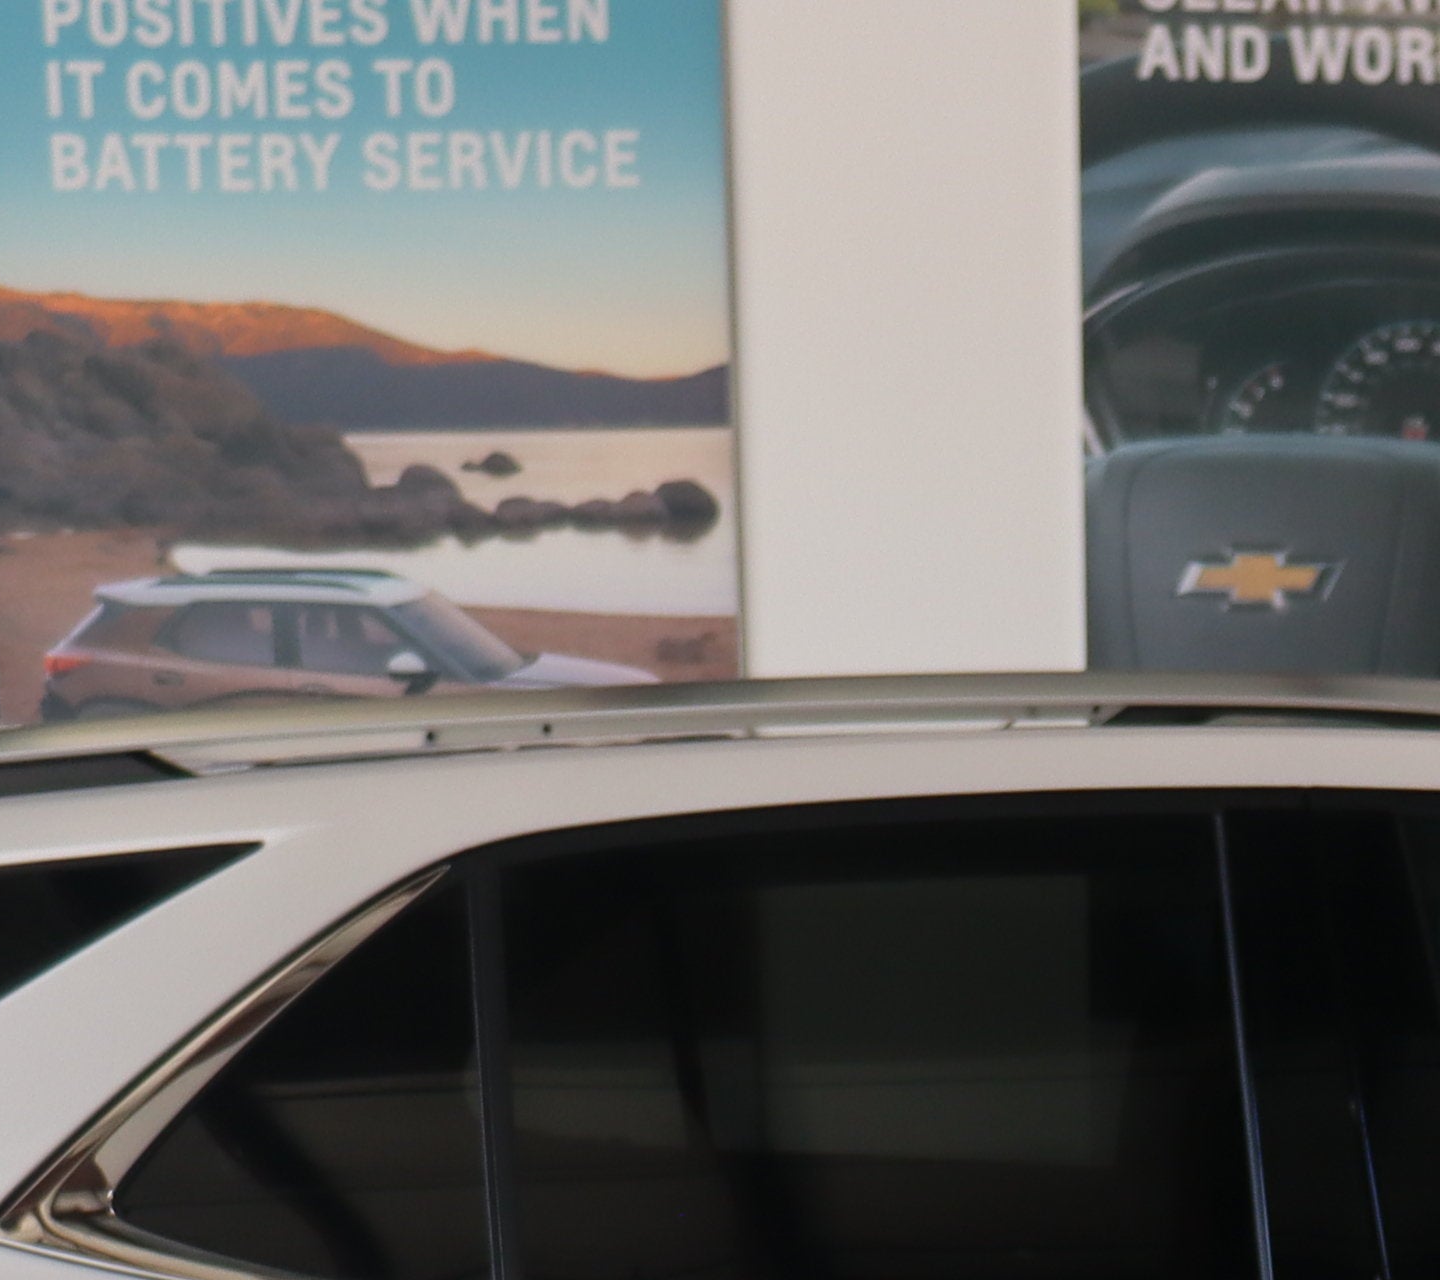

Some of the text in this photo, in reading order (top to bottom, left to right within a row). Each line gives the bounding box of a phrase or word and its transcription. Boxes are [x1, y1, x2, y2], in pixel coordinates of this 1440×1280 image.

[43, 0, 610, 47] POSITIVES WHEN
[1137, 24, 1270, 82] AND
[45, 58, 456, 119] IT COMES TO
[50, 130, 641, 191] BATTERY SERVICE
